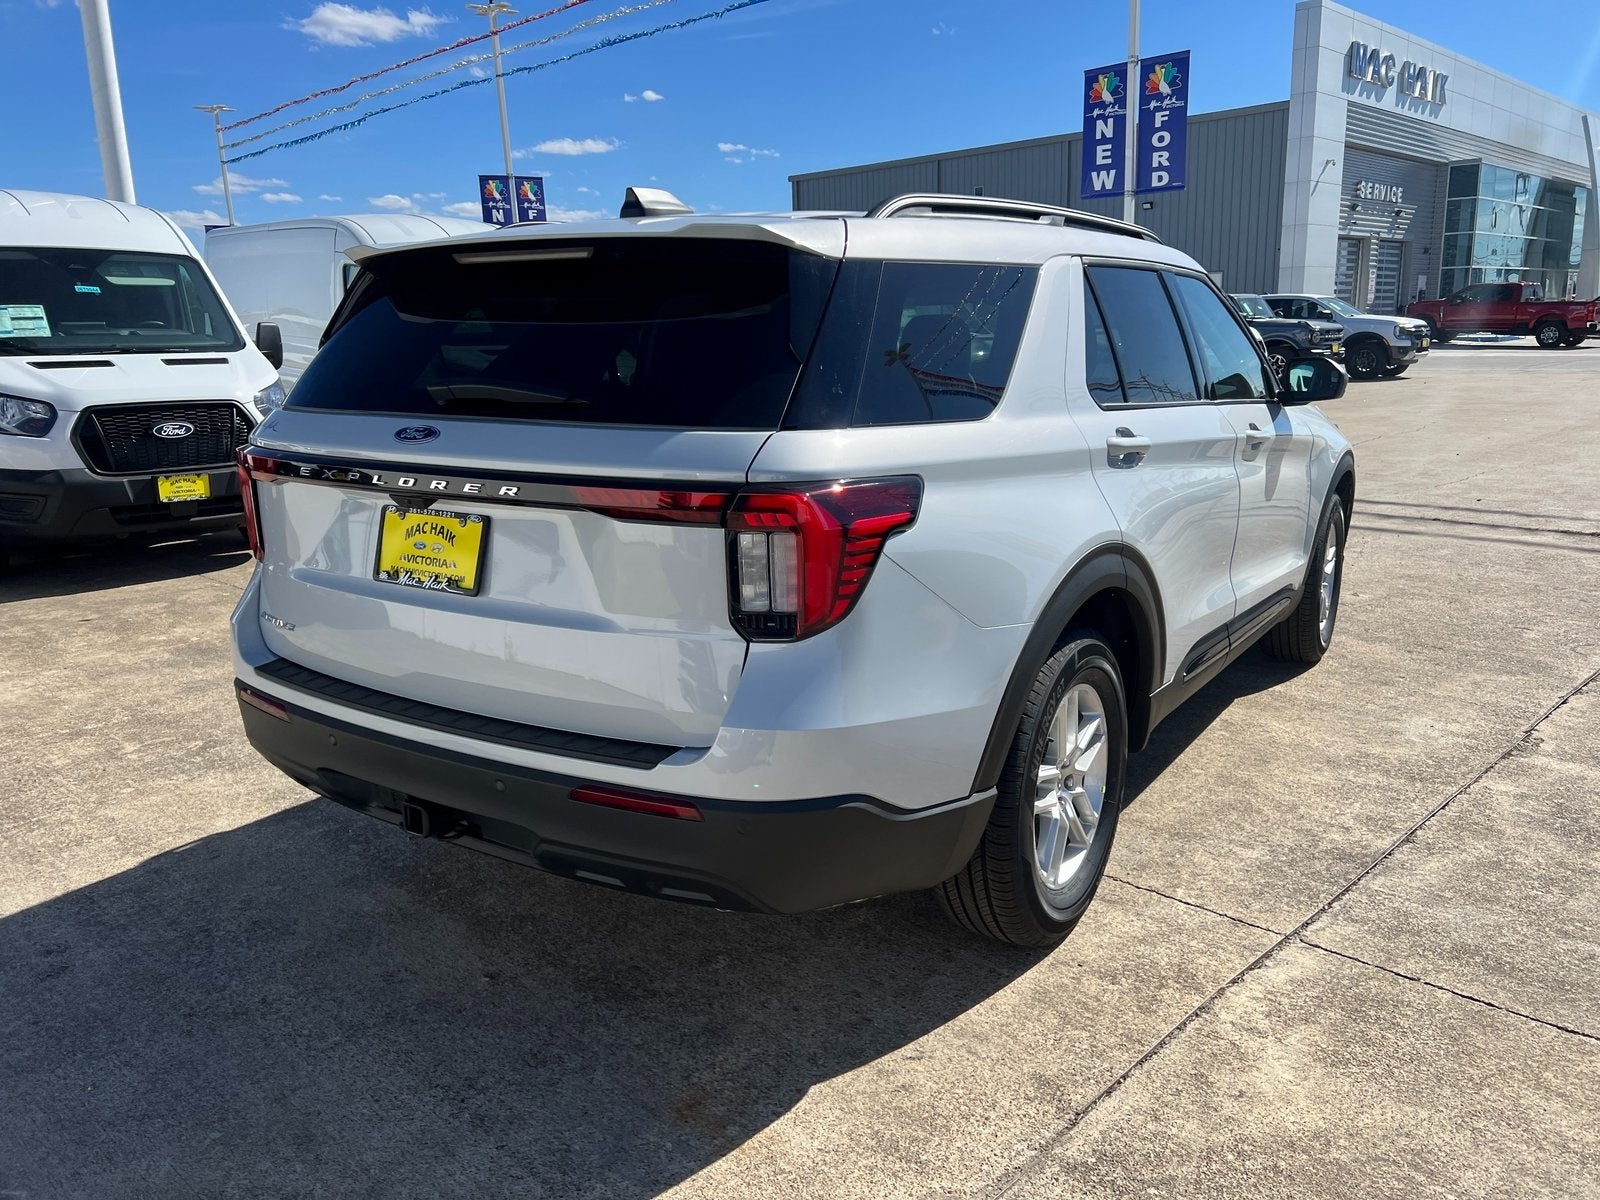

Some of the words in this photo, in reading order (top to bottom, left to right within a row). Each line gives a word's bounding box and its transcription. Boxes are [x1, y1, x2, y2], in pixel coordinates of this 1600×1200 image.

[1350, 41, 1396, 88] MAC
[1401, 61, 1449, 105] HAIK
[1091, 118, 1116, 191] NEW
[1151, 110, 1171, 187] FORD
[1359, 181, 1403, 202] SERVICE
[492, 209, 504, 222] N
[528, 210, 537, 219] F
[161, 425, 186, 436] Ford
[300, 466, 520, 497] EXPLORER
[405, 521, 429, 541] MAC
[430, 522, 457, 547] HAIK
[406, 554, 449, 569] VICTORIA
[397, 571, 421, 586] Mac
[422, 574, 452, 591] Haik
